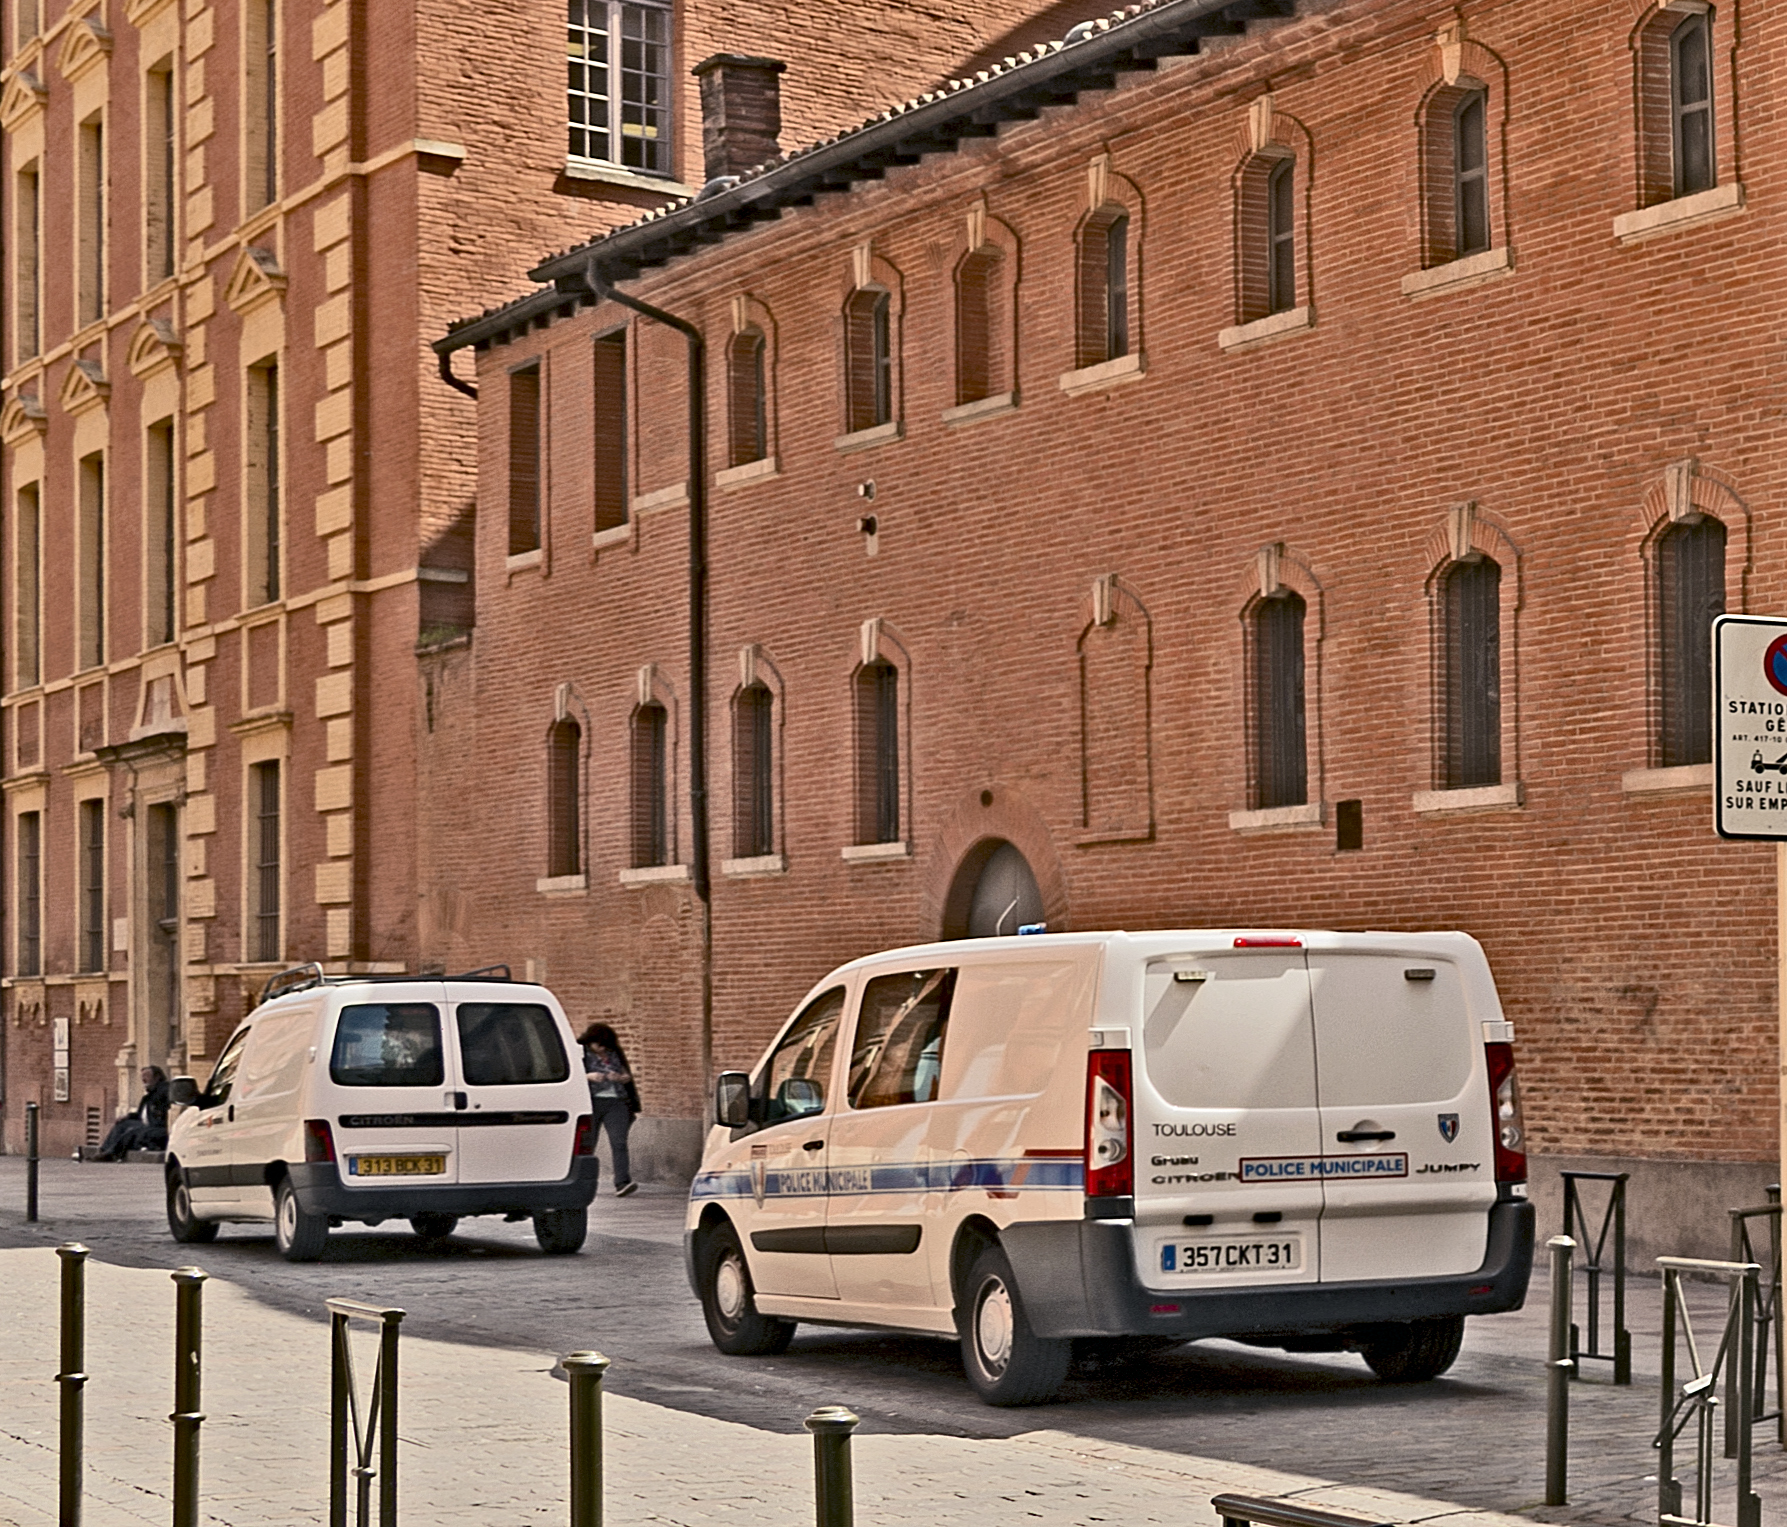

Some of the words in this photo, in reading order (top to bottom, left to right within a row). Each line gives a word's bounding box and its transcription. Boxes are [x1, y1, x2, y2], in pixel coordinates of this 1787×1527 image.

[1736, 779, 1772, 794] SAUF
[1726, 796, 1753, 809] SUR
[1152, 1123, 1237, 1137] TOULOUSE
[363, 1158, 392, 1175] 313
[424, 1156, 442, 1173] 31
[1151, 1155, 1199, 1166] Gruau
[1244, 1162, 1304, 1177] POLICE
[1310, 1159, 1404, 1175] MUNICIPALE
[1415, 1162, 1481, 1175] JUMPY
[780, 1172, 812, 1194] POLICE
[813, 1170, 868, 1193] MUNICIPALE
[1183, 1246, 1222, 1267] 357
[1225, 1244, 1264, 1266] CKT
[1267, 1243, 1291, 1264] 31
